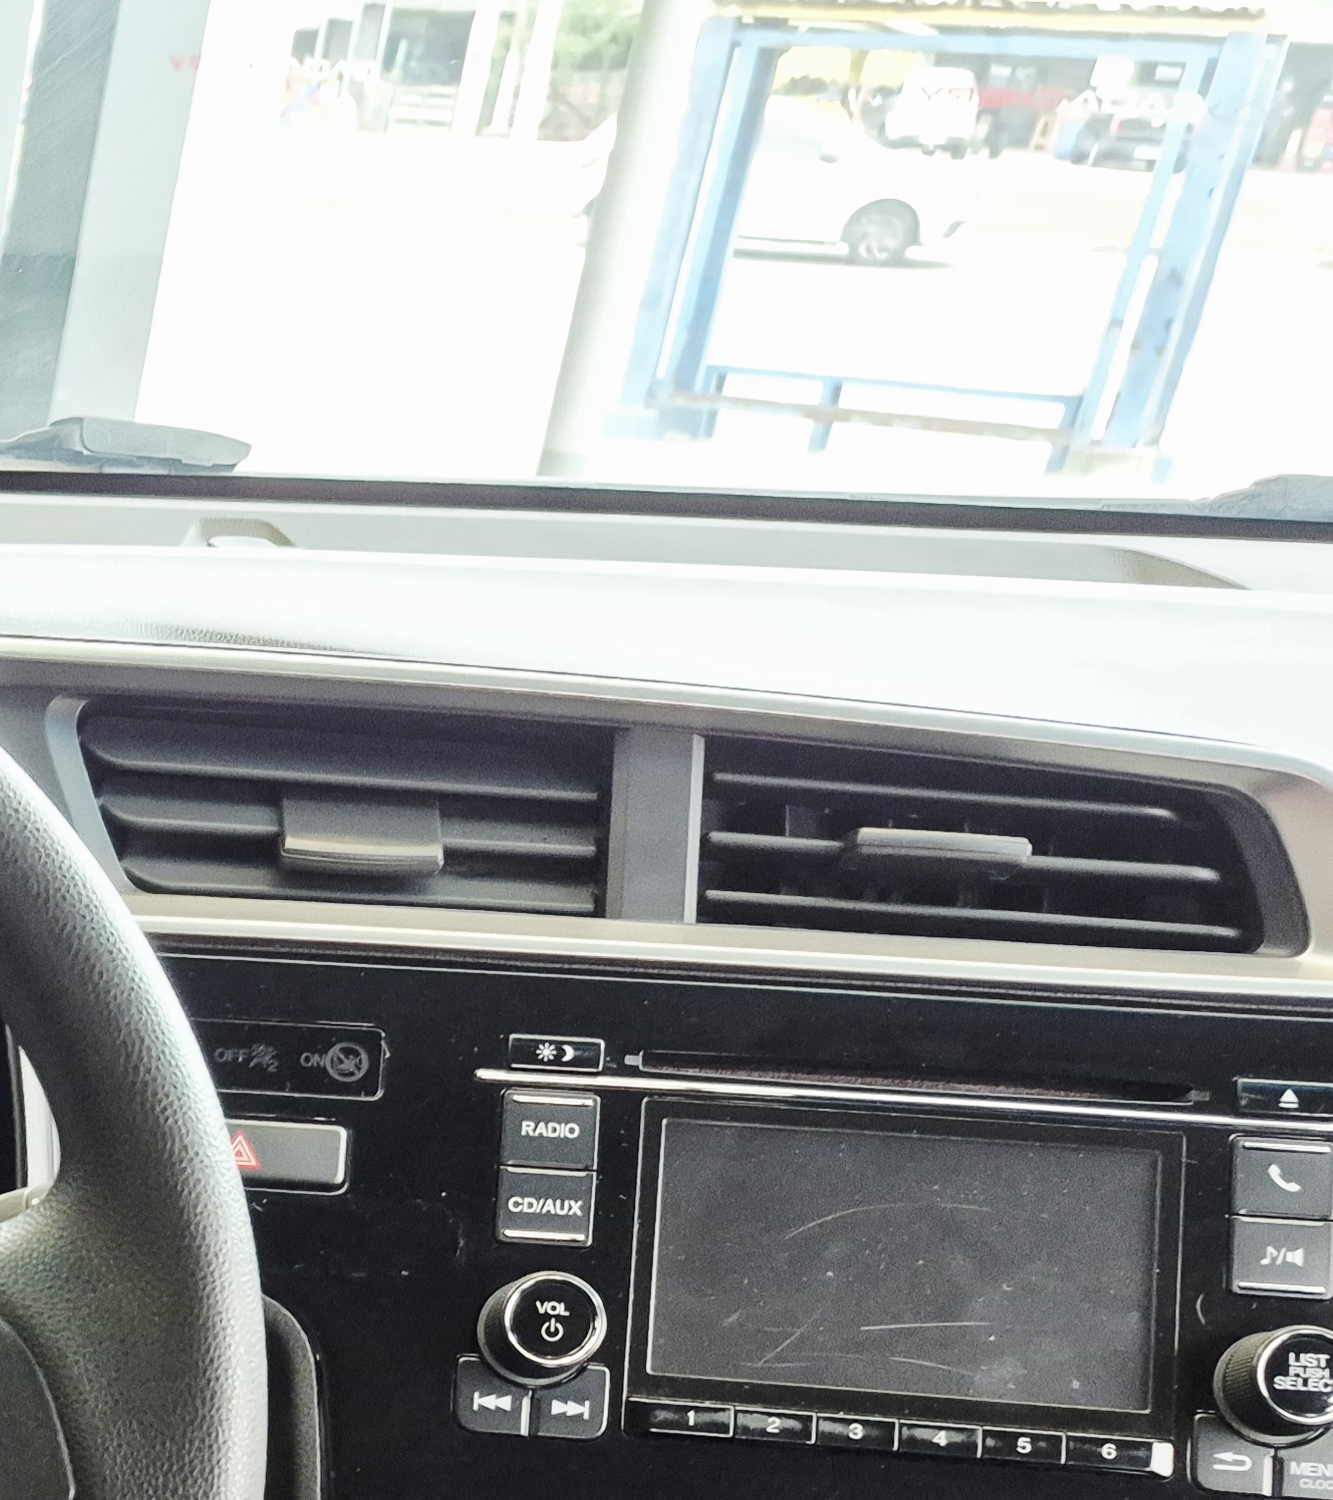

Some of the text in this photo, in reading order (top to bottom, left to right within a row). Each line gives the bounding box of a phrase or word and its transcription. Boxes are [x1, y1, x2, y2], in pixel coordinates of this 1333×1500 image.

[214, 1048, 250, 1062] OFF
[301, 1052, 326, 1068] ON
[521, 1121, 580, 1138] RADIO
[508, 1198, 583, 1216] CD/AUX
[536, 1301, 570, 1316] VOL
[1289, 1352, 1330, 1367] LIST
[1289, 1367, 1330, 1378] PUSH
[1273, 1377, 1333, 1391] SELEC
[686, 1411, 695, 1426] 1
[767, 1418, 780, 1433] 2
[849, 1424, 863, 1439] 3
[932, 1431, 948, 1447] 4
[1017, 1438, 1032, 1454] 5
[1102, 1444, 1117, 1460] 6
[1290, 1462, 1333, 1476] MEN
